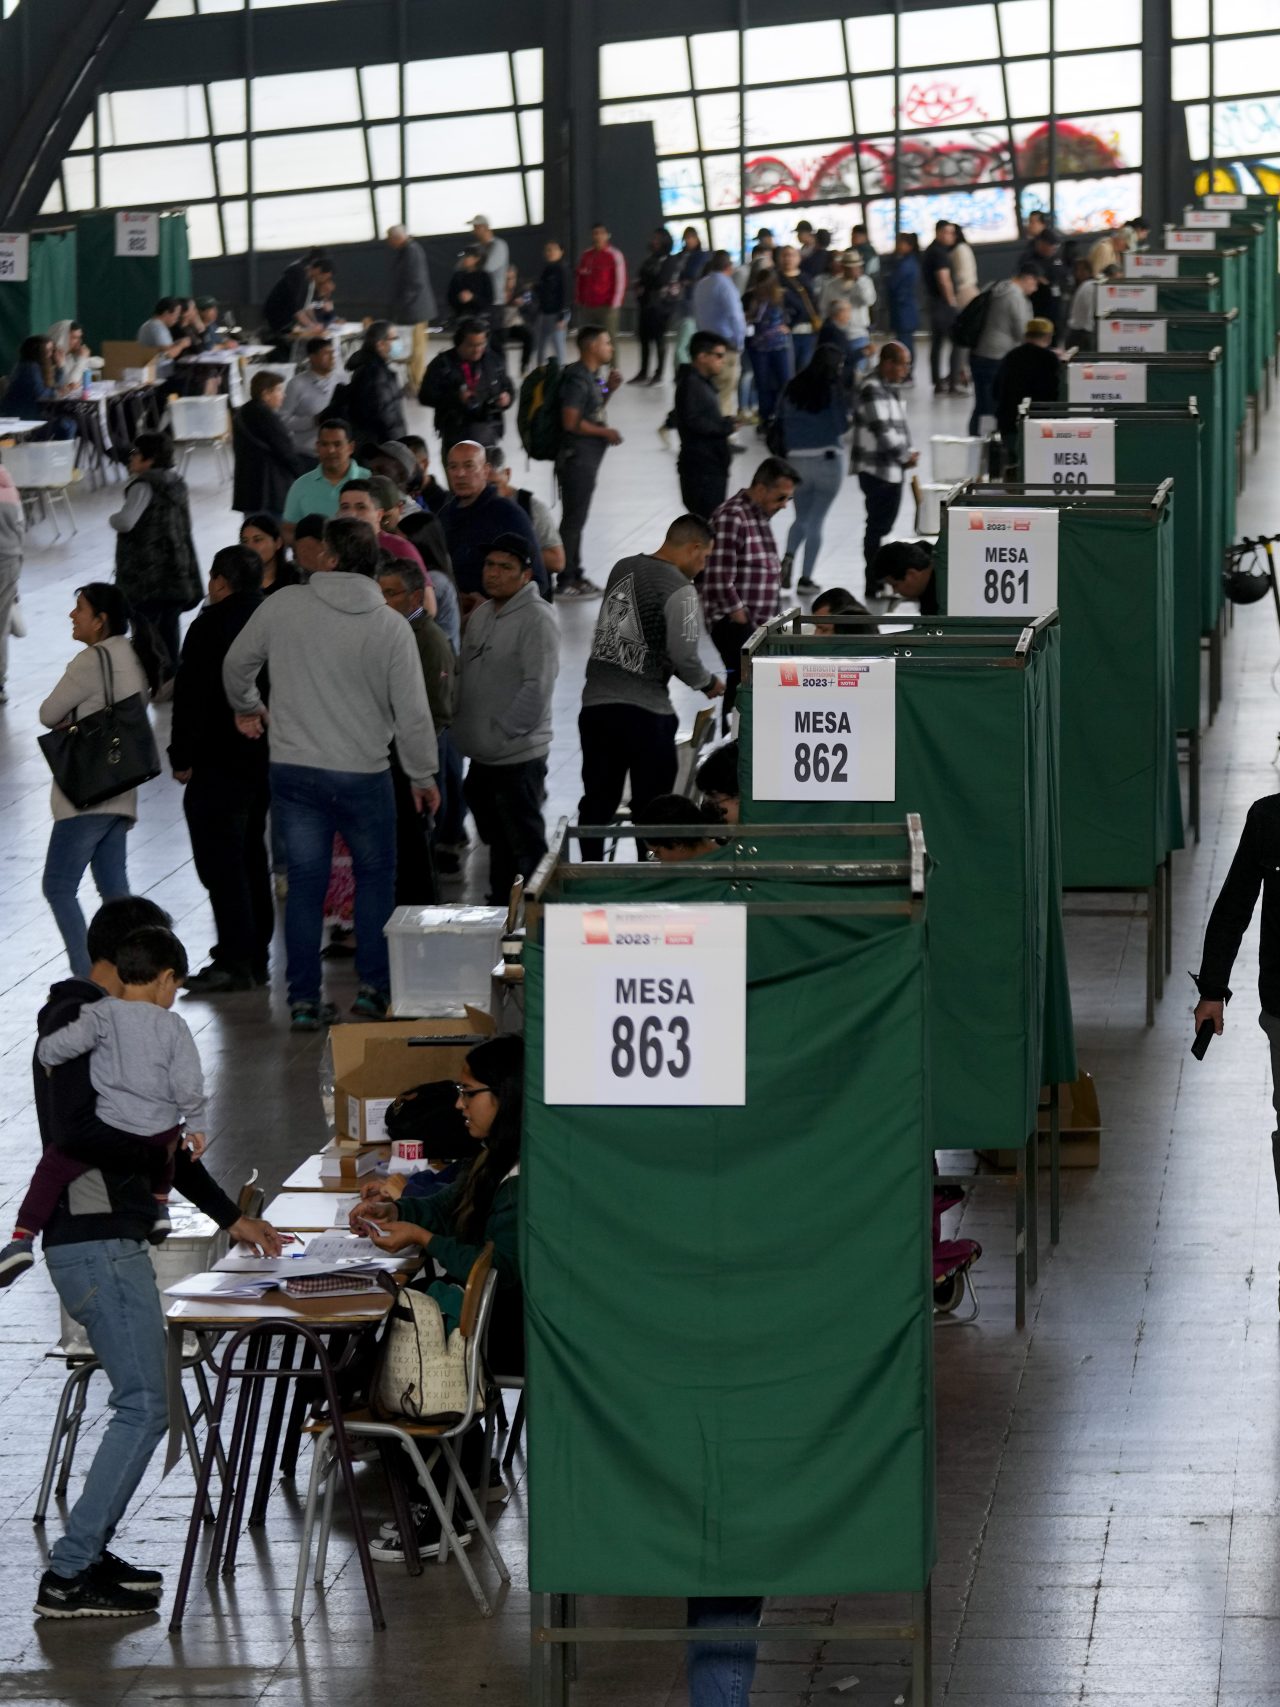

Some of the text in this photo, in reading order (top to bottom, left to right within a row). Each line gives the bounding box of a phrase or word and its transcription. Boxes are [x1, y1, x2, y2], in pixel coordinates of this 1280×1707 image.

[1054, 453, 1088, 465] MESA
[985, 547, 1028, 563] MESA
[984, 569, 1028, 604] 861
[795, 711, 851, 733] MESA
[794, 743, 848, 782] 862
[616, 978, 695, 1004] MESA
[611, 1015, 691, 1078] 863
